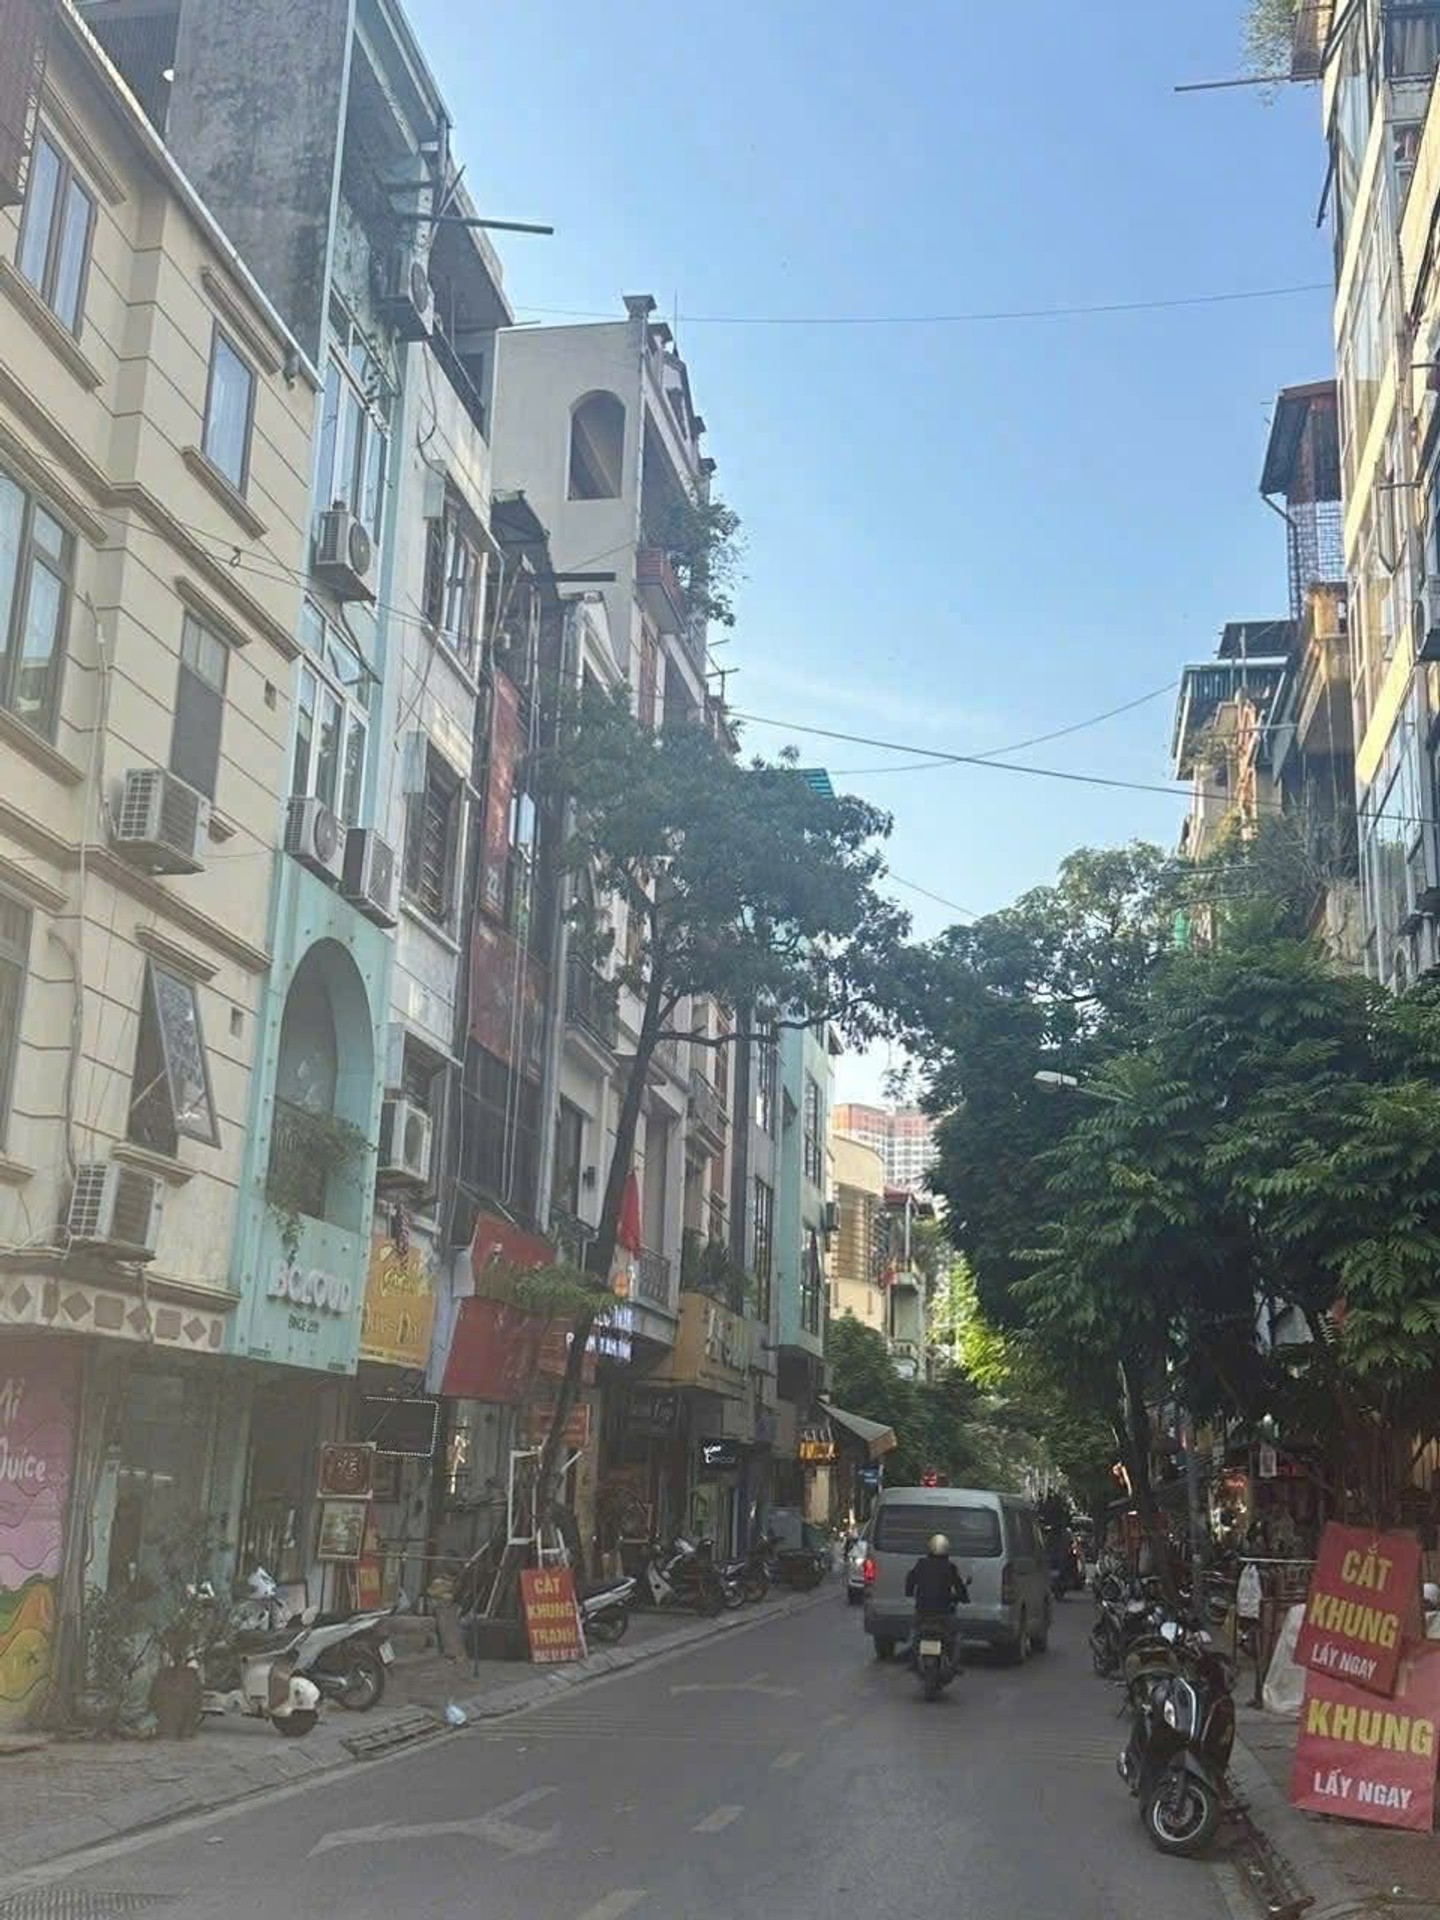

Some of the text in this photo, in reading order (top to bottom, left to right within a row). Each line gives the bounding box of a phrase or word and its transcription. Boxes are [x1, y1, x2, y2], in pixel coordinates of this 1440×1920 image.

[1342, 1541, 1393, 1591] CẮT
[527, 1602, 576, 1619] KHUNG
[1309, 1593, 1399, 1649] KHUNG
[531, 1628, 577, 1646] TRANH
[1339, 1652, 1377, 1680] NGAY
[1307, 1698, 1434, 1756] KHUNG
[1314, 1768, 1412, 1809] LẤY NGAY
